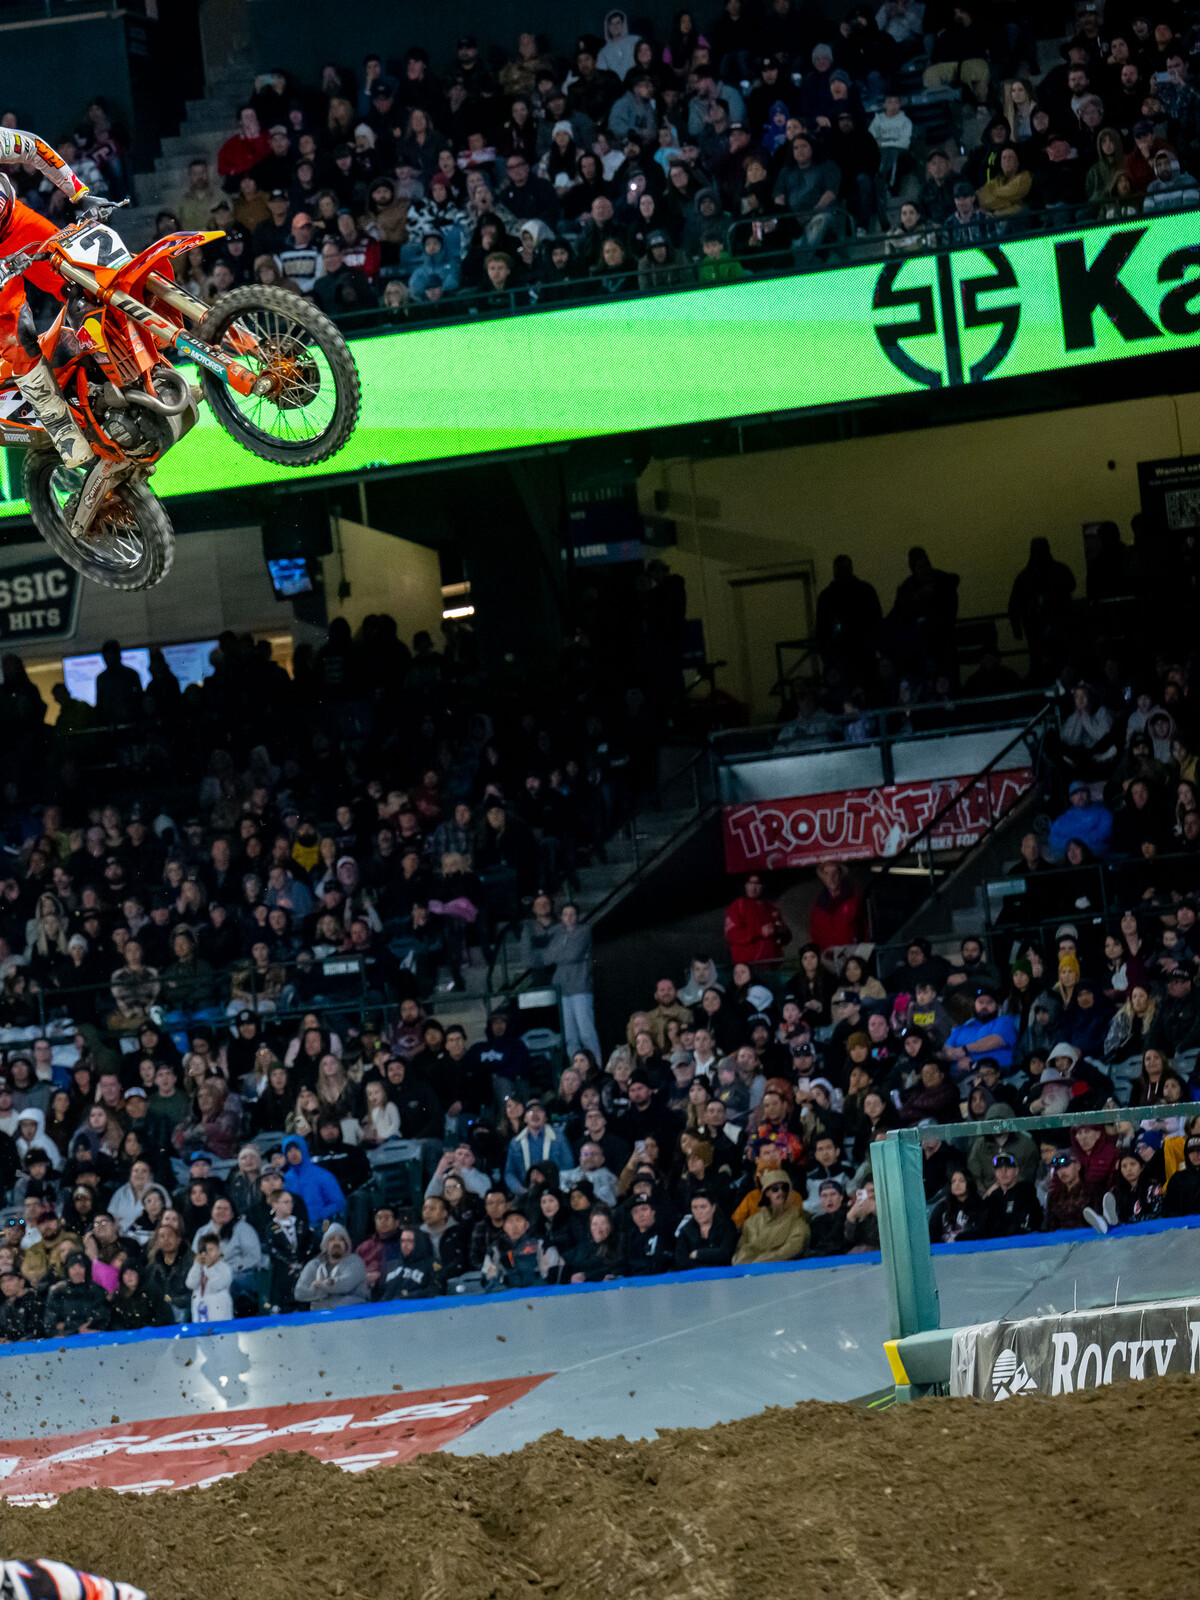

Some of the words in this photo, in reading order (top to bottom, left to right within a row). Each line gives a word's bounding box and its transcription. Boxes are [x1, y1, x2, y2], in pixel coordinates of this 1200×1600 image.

[79, 229, 129, 268] 2
[1054, 227, 1200, 353] Ka
[190, 349, 226, 375] MOTOREX
[8, 607, 61, 632] HITS
[728, 798, 874, 858] TROUT
[1052, 1331, 1177, 1397] ROCKY
